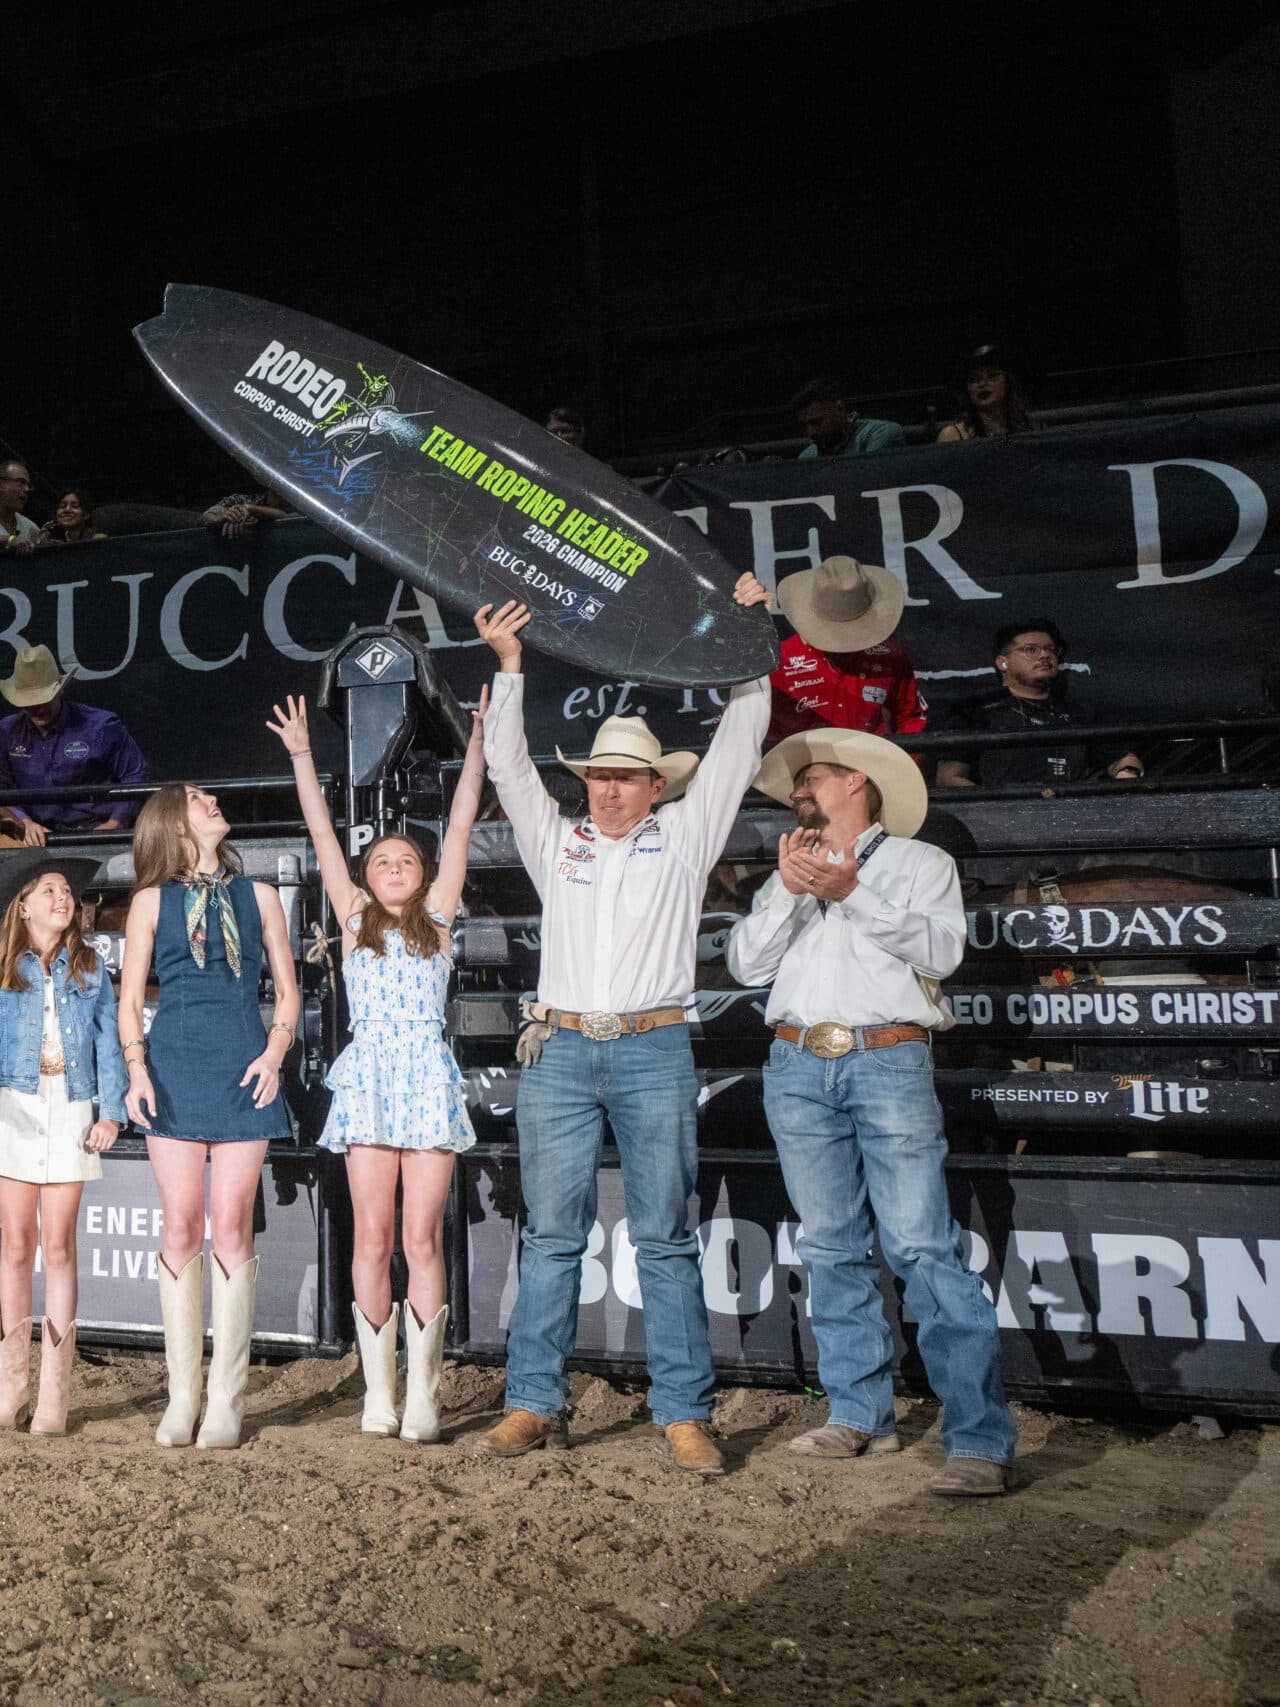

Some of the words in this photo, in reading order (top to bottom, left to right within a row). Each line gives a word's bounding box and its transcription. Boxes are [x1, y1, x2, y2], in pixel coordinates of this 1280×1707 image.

[245, 340, 346, 419] RODEO
[234, 380, 274, 413] CORPUS
[273, 405, 318, 438] CHRISTI
[419, 425, 488, 480] TEAM
[476, 460, 567, 528] ROPING
[556, 508, 649, 577] HEADER
[488, 545, 525, 576] BUC
[530, 571, 578, 607] DAYS
[522, 524, 558, 554] 2026
[556, 544, 627, 594] CHAMPION
[562, 681, 648, 720] est.
[965, 909, 1038, 949] UC
[1078, 905, 1227, 948] DAYS
[1006, 993, 1140, 1026] CORPUS
[1151, 992, 1280, 1026] CHRIST
[971, 1088, 1079, 1103] PRESENTED
[1084, 1091, 1109, 1104] BY
[1128, 1080, 1209, 1122] Lite
[93, 1249, 160, 1280] LIVE
